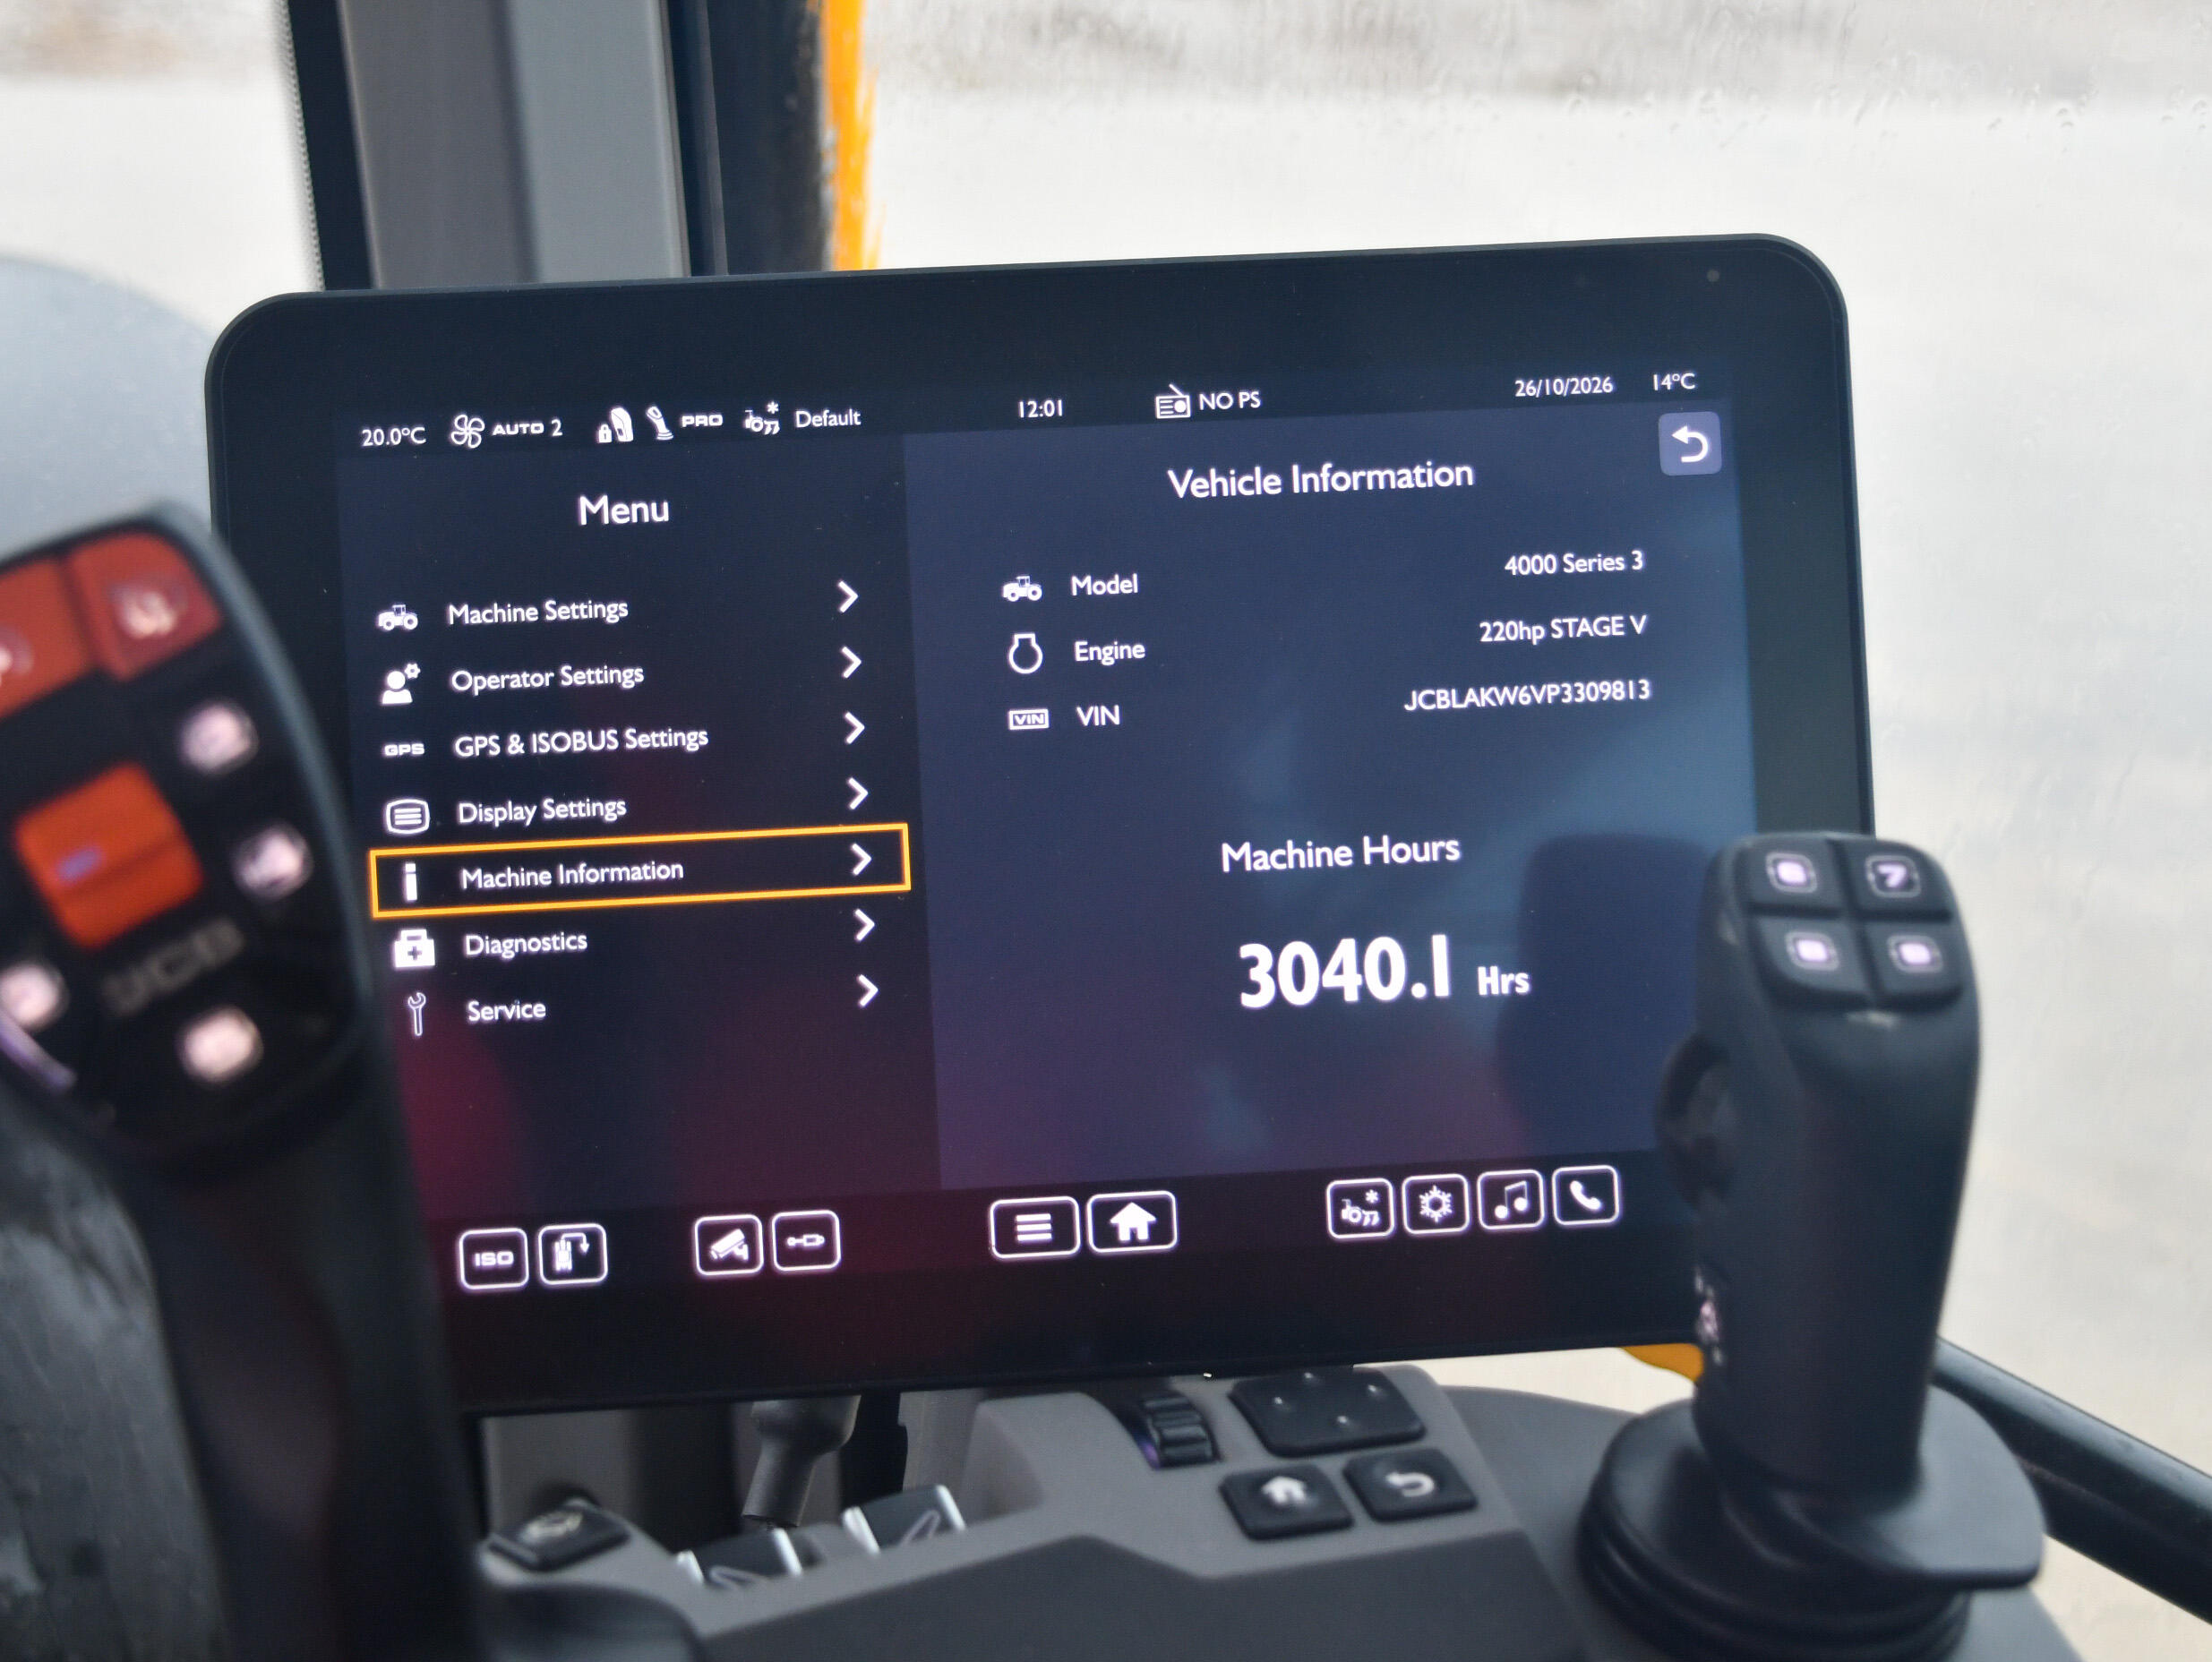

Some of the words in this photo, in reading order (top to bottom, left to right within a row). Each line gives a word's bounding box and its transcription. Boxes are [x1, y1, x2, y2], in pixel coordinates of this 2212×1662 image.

[1514, 376, 1614, 398] 26/10/2026
[1653, 372, 1696, 391] 14°C
[1018, 398, 1063, 418] 12:01
[1198, 391, 1234, 411] NO
[1238, 390, 1261, 409] PS
[492, 422, 544, 436] AUTO
[551, 418, 563, 437] 2
[680, 414, 724, 428] PRO
[794, 407, 862, 428] Default
[361, 426, 426, 447] 20.0°C
[1167, 466, 1282, 499] Vehicle
[1291, 460, 1474, 493] Information
[578, 494, 670, 526] Menu
[1504, 553, 1558, 576] 4000
[1563, 553, 1626, 574] Series
[1631, 549, 1644, 570] 3
[1071, 572, 1138, 596] Model
[447, 602, 539, 625] Machine
[544, 599, 629, 624] Settings
[1479, 620, 1546, 646] 220hp
[1550, 615, 1625, 639] STAGE
[1629, 614, 1647, 635] V
[1074, 640, 1146, 666] Engine
[450, 669, 555, 697] Operator
[559, 664, 645, 690] Settings
[1403, 678, 1651, 711] JCBLAKW6VP3309813
[1014, 713, 1045, 726] VIN
[1076, 704, 1120, 726] VIN
[382, 742, 425, 758] GPS
[453, 734, 502, 758] GPS
[506, 732, 526, 756] &
[531, 728, 620, 754] ISOBUS
[623, 727, 709, 752] Settings
[458, 800, 538, 828] Display
[542, 797, 628, 823] Settings
[1222, 839, 1354, 873] Machine
[1362, 834, 1462, 865] Hours
[460, 866, 553, 890] Machine
[557, 861, 684, 885] Information
[464, 931, 588, 961] Diagnostics
[1239, 933, 1451, 1009] 3040.1
[1477, 964, 1530, 997] Hrs
[466, 999, 546, 1023] Service
[474, 1250, 515, 1267] ISO
